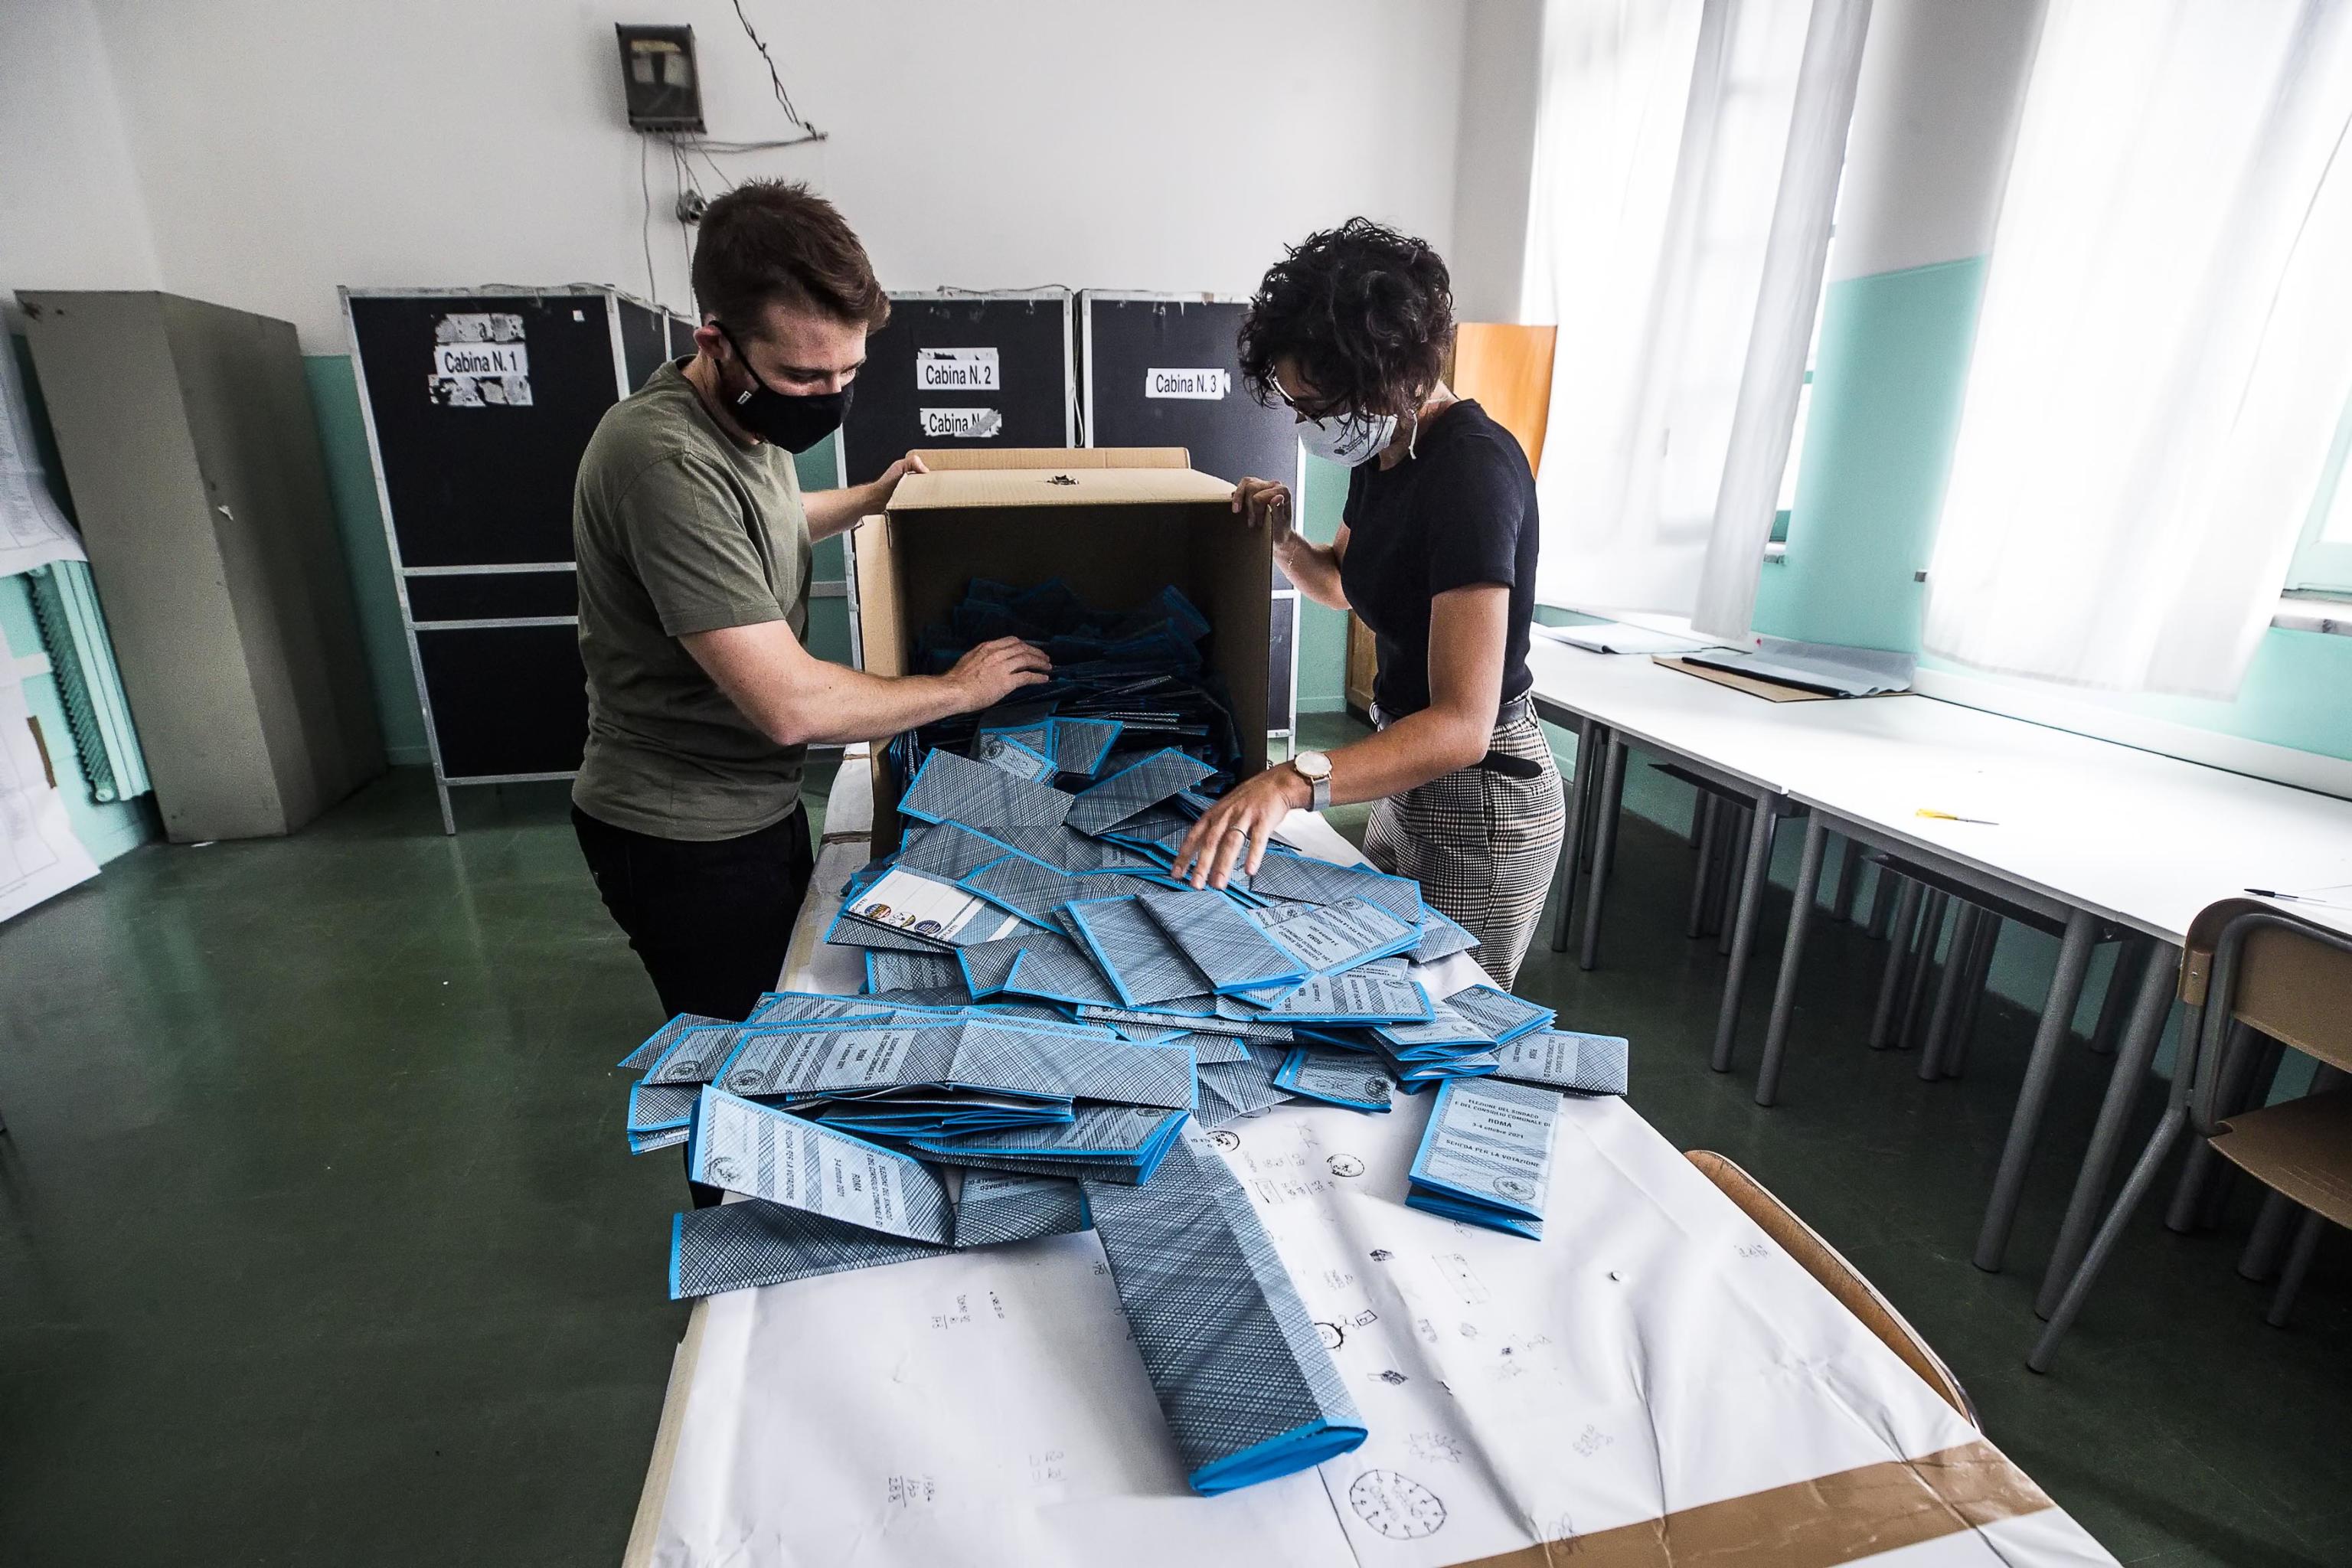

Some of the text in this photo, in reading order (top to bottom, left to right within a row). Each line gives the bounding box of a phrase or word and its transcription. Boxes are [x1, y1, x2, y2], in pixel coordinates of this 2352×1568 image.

[444, 351, 518, 374] Cabina N. 1
[926, 364, 991, 384] Cabina N. 2
[1155, 374, 1217, 393] Cabina N. 3
[929, 413, 969, 433] Cabina
[1468, 1099, 1497, 1110] ELEZIONE
[1511, 1109, 1540, 1119] SINDACO
[1473, 1105, 1507, 1118] CONSIGLIO
[1508, 1113, 1542, 1125] COMUNALE
[1484, 1125, 1507, 1135] ottobre
[1488, 1117, 1513, 1129] ROMA
[1446, 1138, 1473, 1151] SCHEDA
[1475, 1146, 1489, 1155] PER
[1501, 1153, 1540, 1168] VOTAZIONE
[851, 1172, 862, 1192] ROMA
[979, 1181, 1009, 1191] SINDACO
